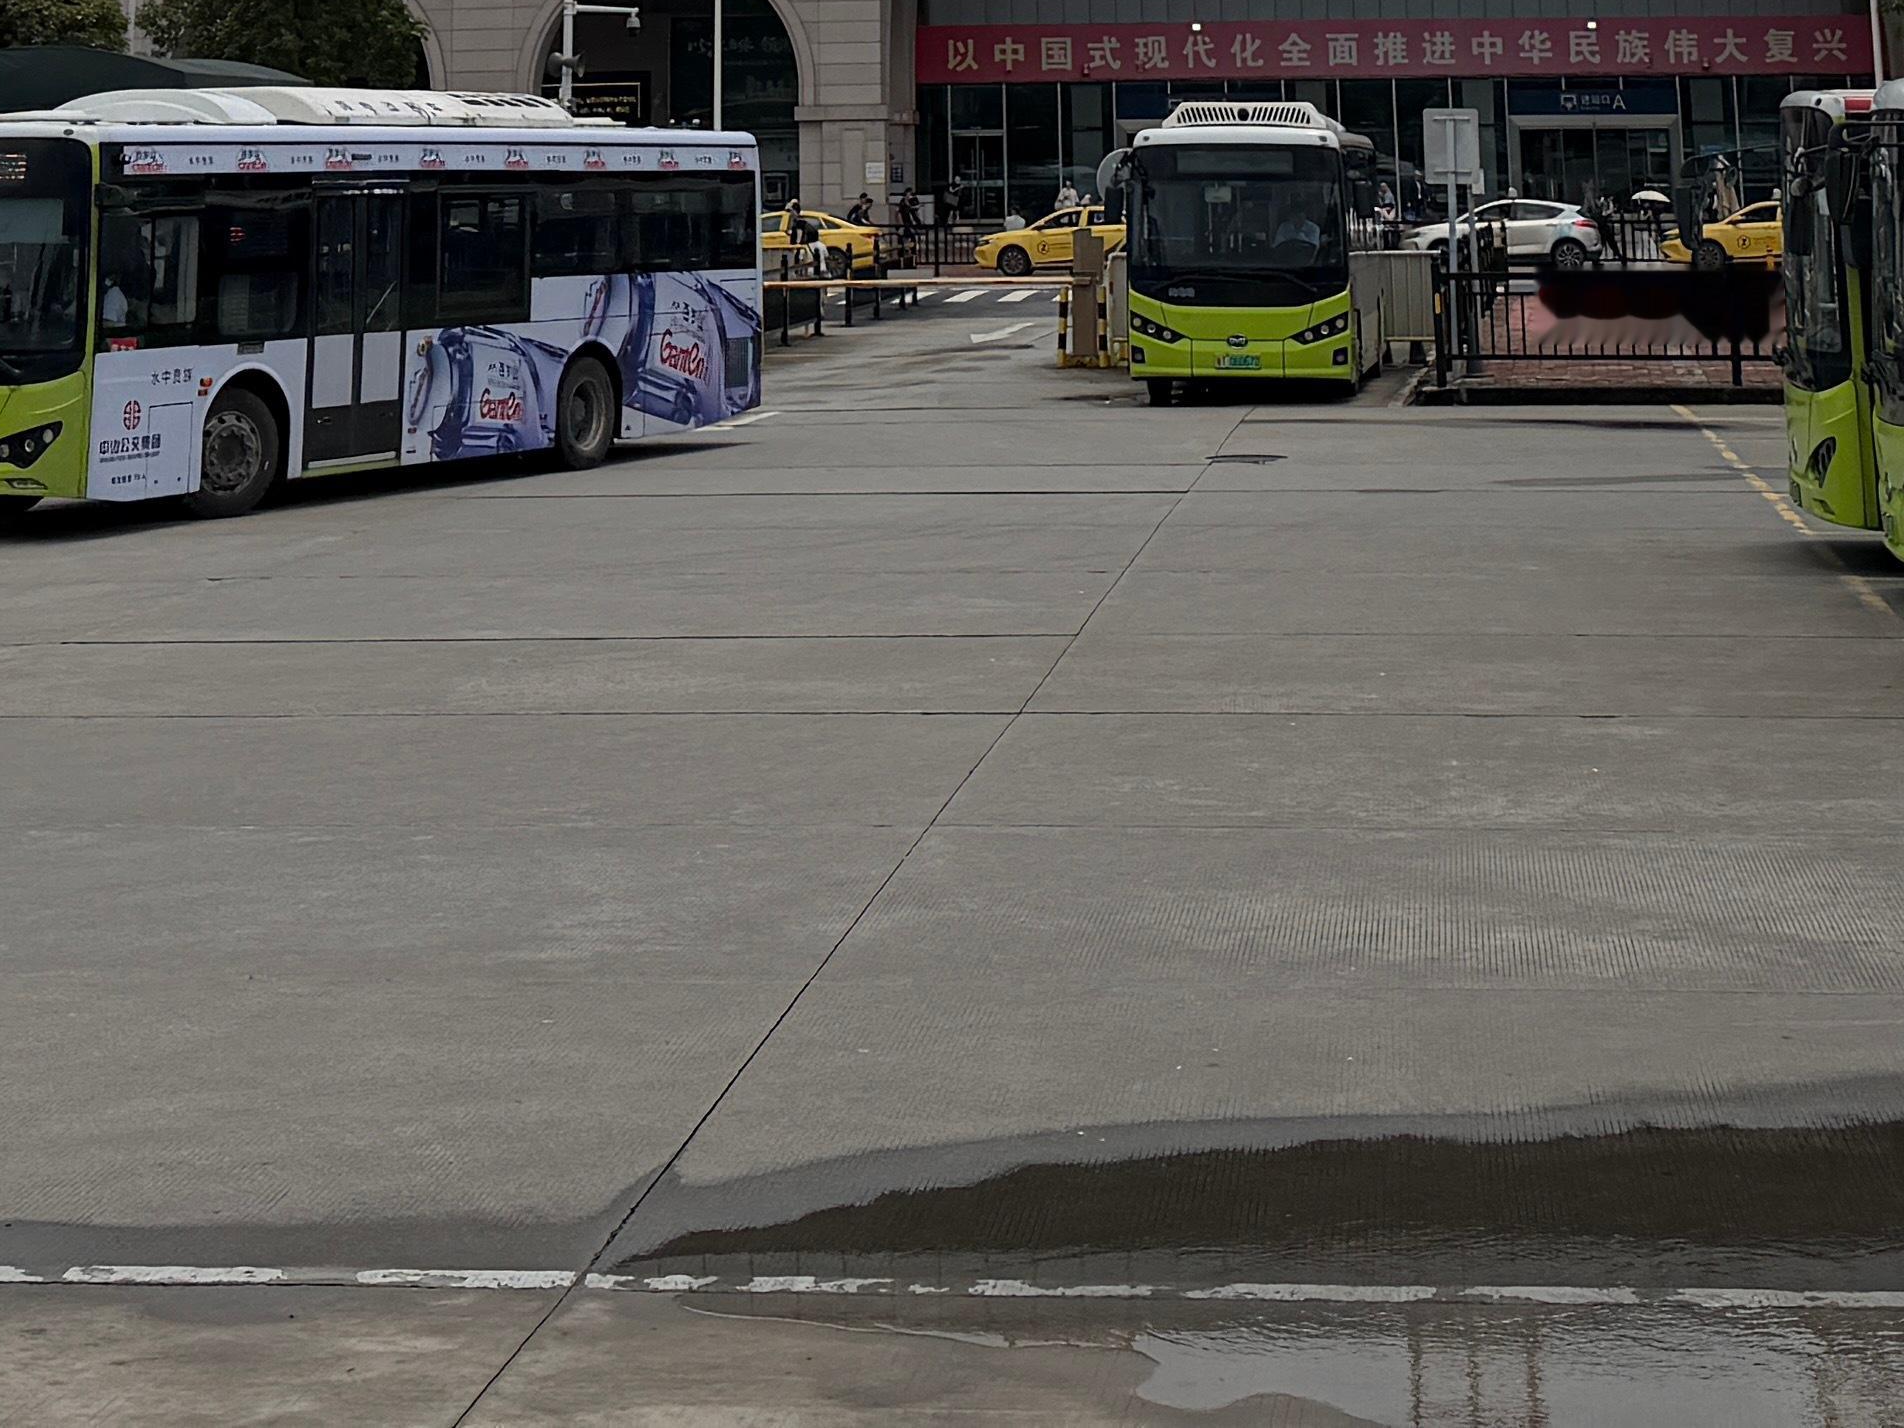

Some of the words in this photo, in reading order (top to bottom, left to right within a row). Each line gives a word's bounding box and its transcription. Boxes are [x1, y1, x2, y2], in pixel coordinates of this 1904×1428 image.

[946, 27, 1849, 72] 以中国式现代化全面推进中华民族伟大复兴
[1612, 93, 1627, 110] A
